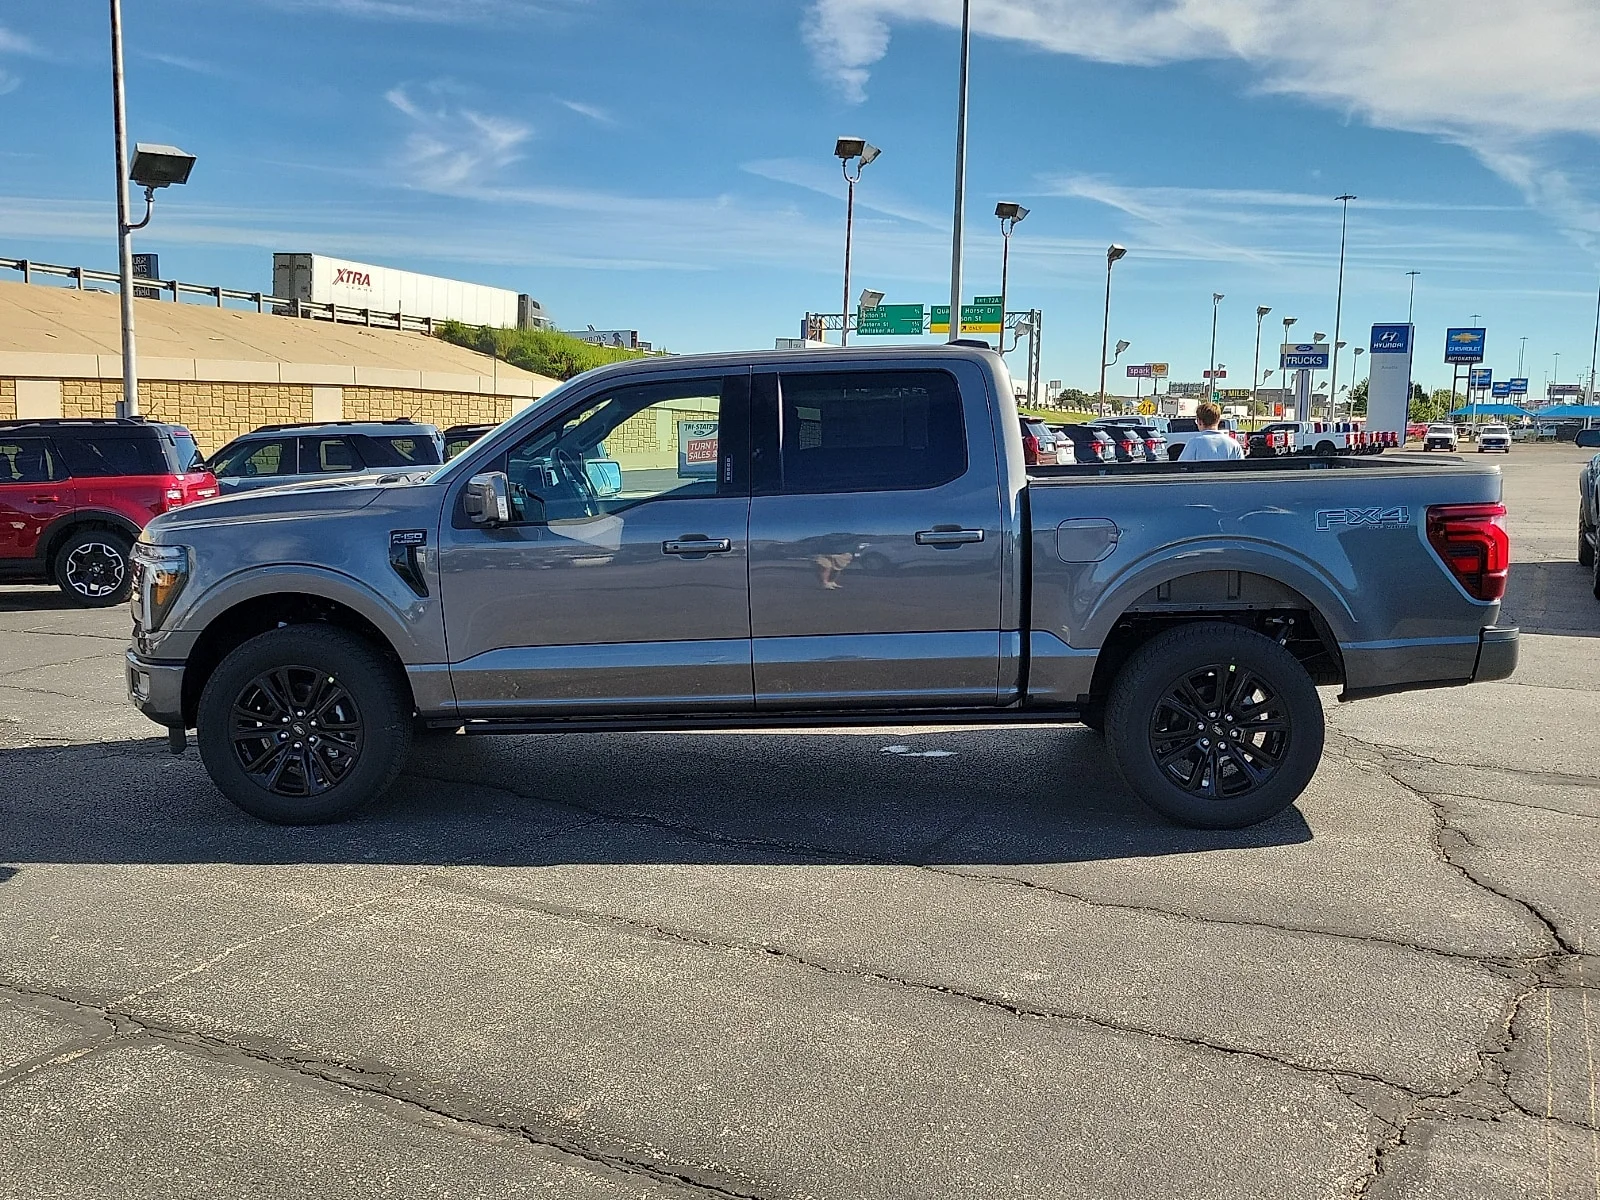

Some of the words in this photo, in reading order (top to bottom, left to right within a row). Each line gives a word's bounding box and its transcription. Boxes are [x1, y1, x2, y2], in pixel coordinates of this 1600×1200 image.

[133, 264, 147, 272] INTS
[332, 267, 371, 287] XTRA
[1286, 356, 1323, 365] TRUCKS
[1228, 389, 1249, 397] MILES
[684, 423, 713, 431] TRI-STATE
[690, 441, 711, 451] TURN
[688, 450, 711, 460] SALES
[1315, 505, 1410, 531] FX4
[392, 532, 423, 540] F-150
